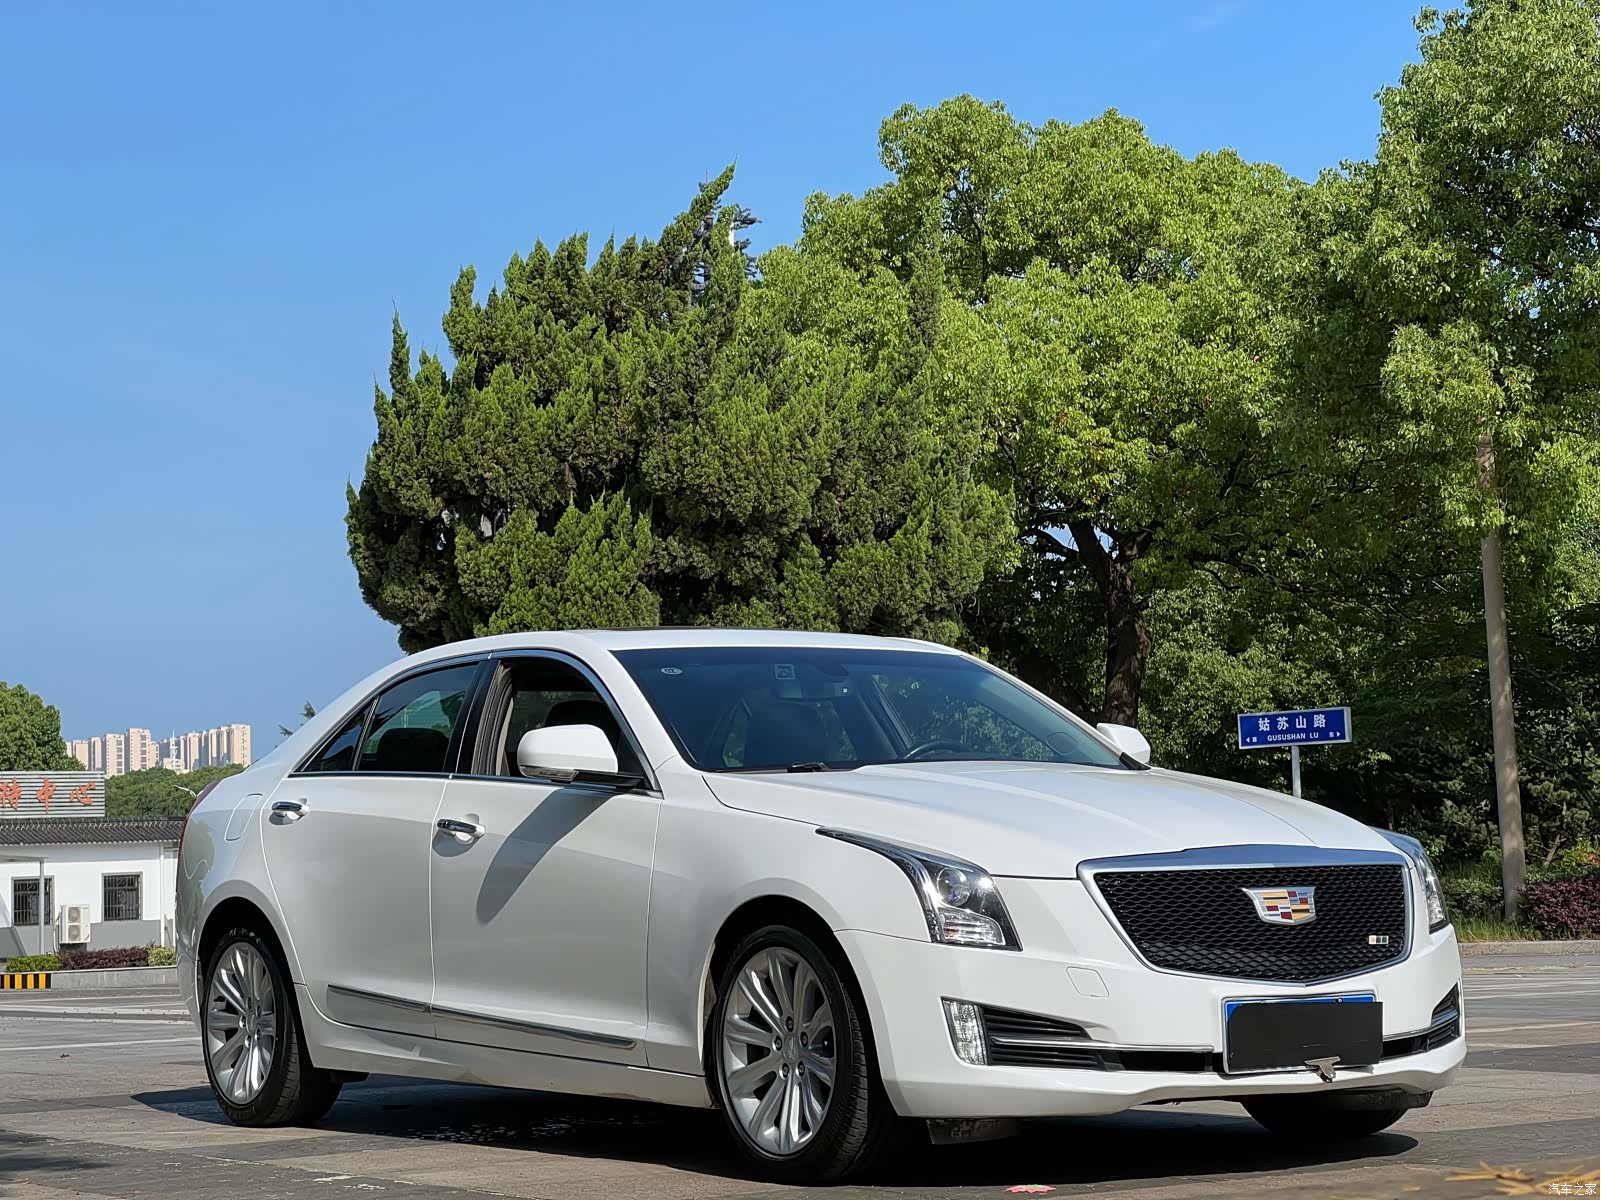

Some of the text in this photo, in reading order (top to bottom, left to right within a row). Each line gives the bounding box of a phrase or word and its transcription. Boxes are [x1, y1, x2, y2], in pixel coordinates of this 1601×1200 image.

[1258, 714, 1326, 731] 姑苏山路
[1267, 733, 1306, 742] GUSUSHAN
